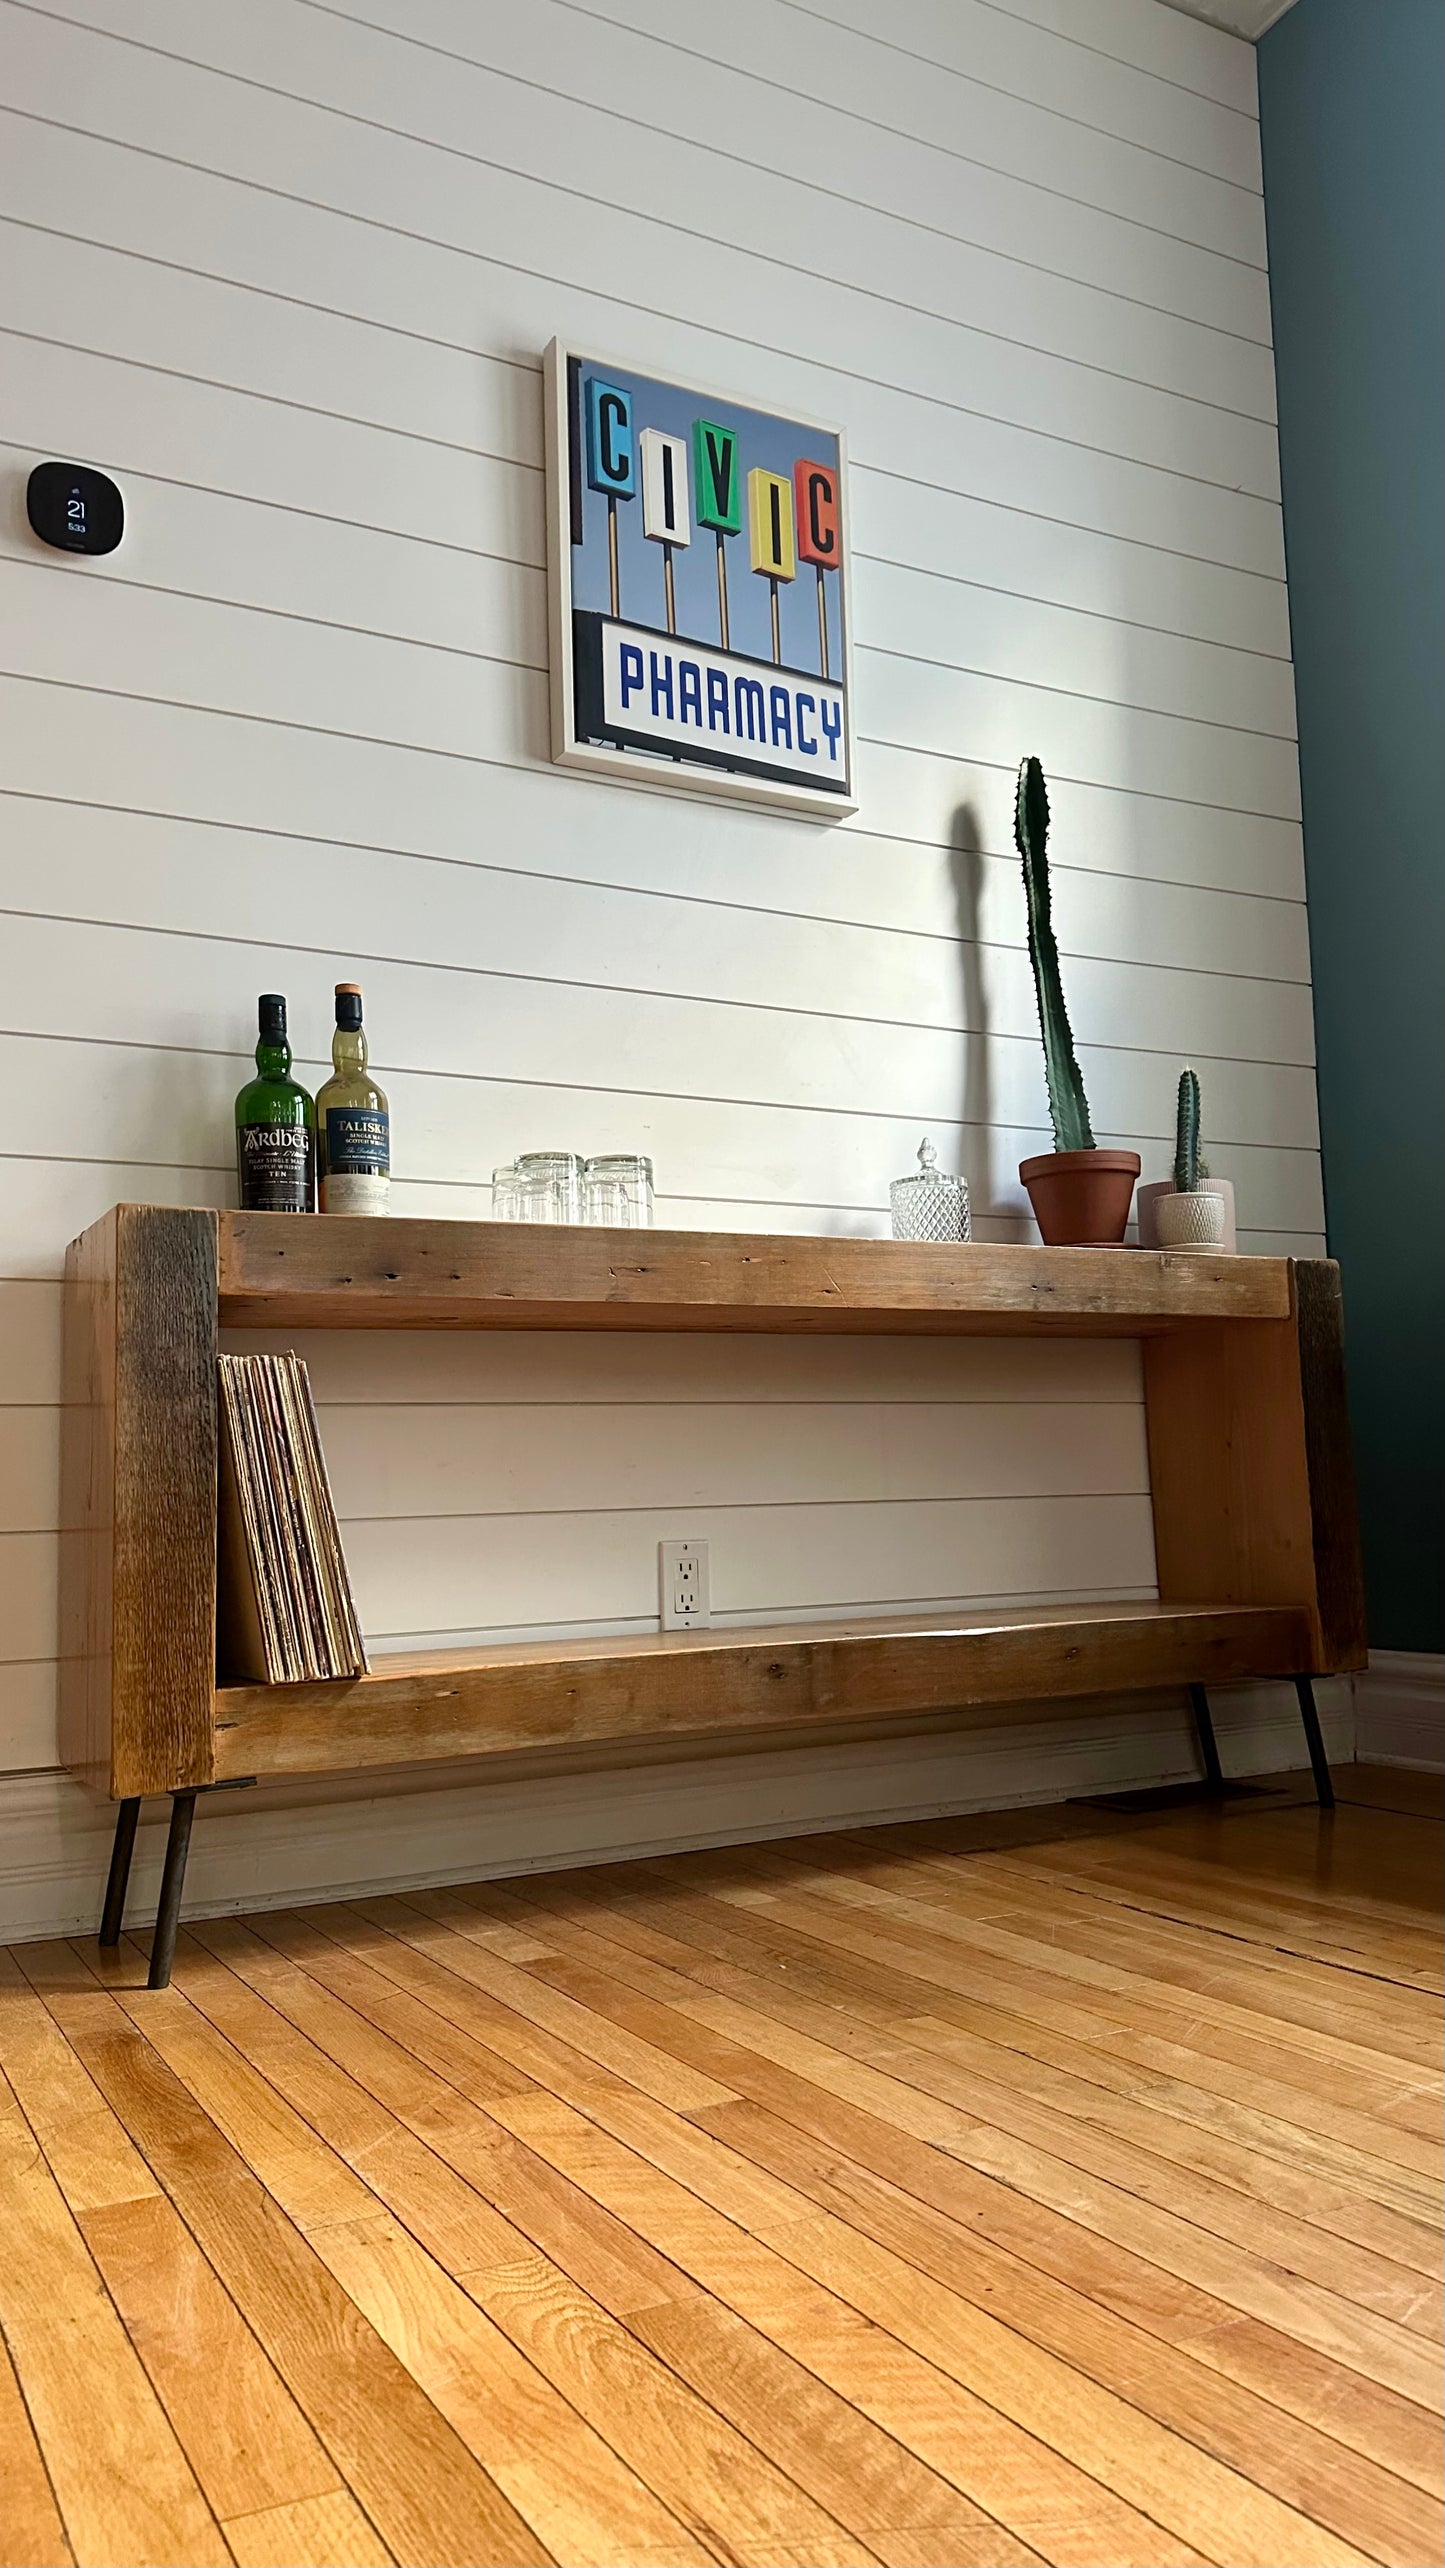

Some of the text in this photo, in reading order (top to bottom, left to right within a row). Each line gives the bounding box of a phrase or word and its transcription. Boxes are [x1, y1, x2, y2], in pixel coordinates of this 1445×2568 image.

[67, 499, 85, 519] 21
[599, 392, 835, 566] CIVIC
[620, 642, 841, 761] PHARMACY
